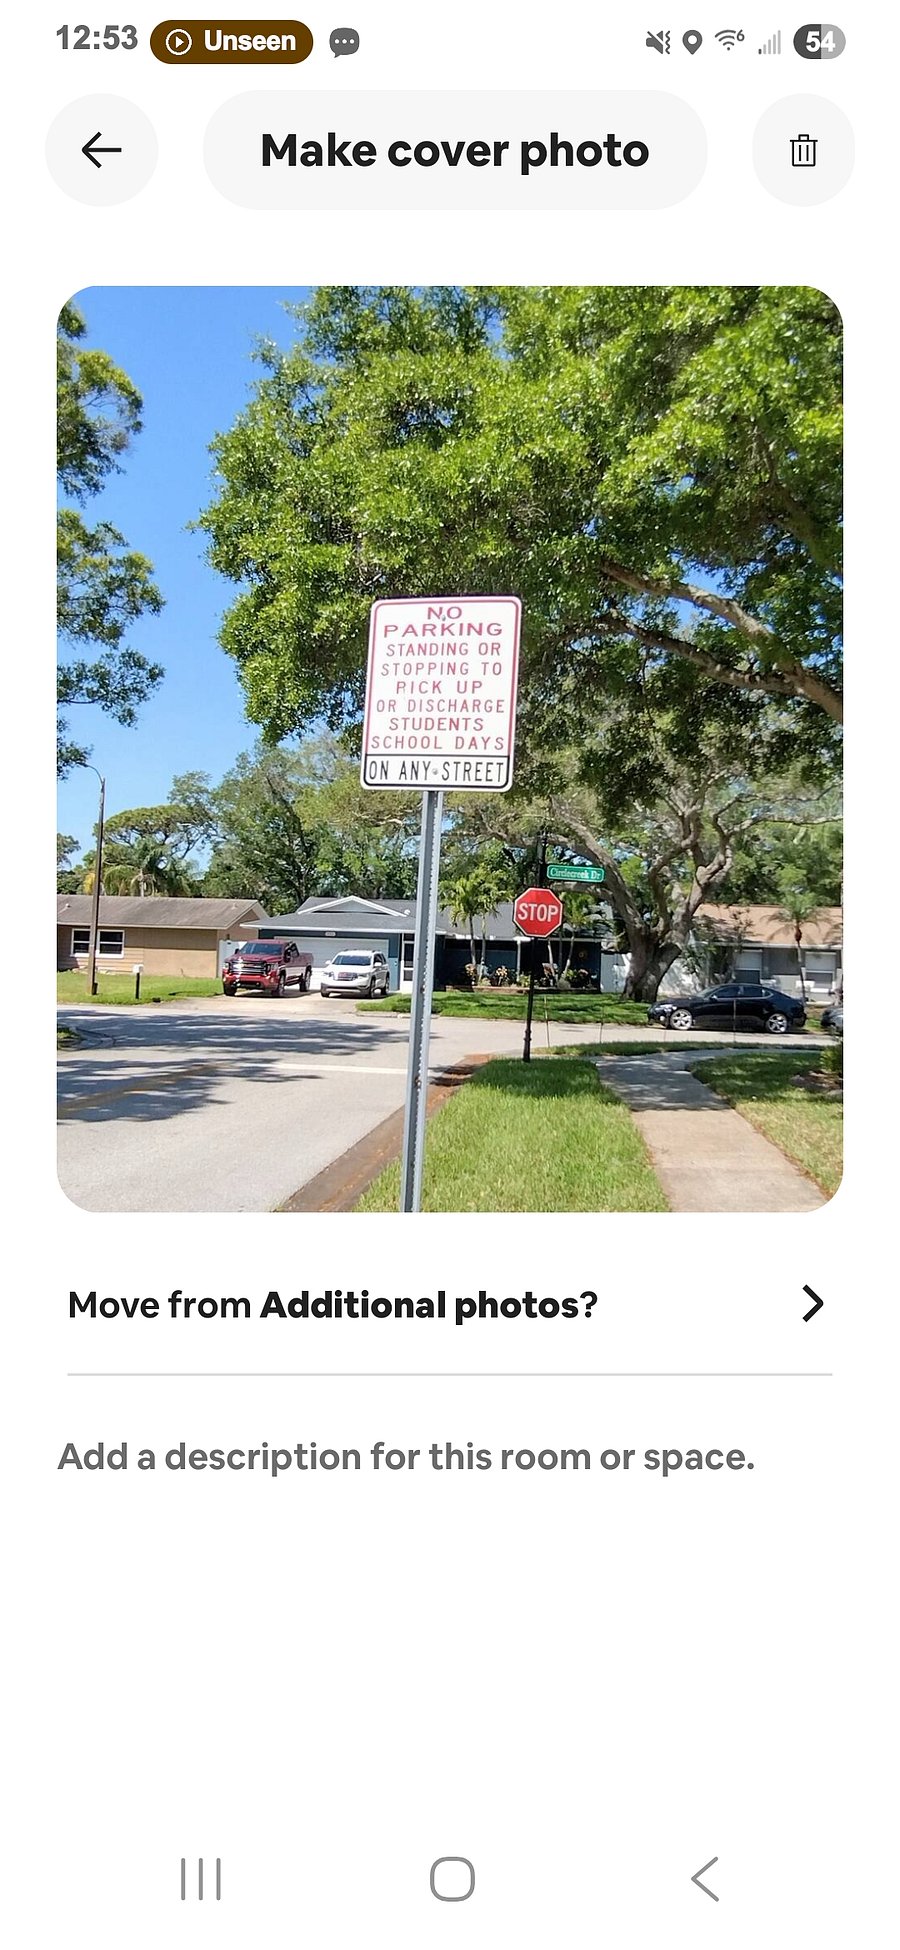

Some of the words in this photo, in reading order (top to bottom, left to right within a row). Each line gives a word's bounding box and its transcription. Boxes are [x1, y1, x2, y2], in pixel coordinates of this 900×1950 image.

[57, 25, 138, 50] 12:53
[205, 30, 295, 51] Unseen
[805, 31, 836, 53] 54
[262, 132, 377, 167] Make
[388, 141, 509, 167] cover
[521, 132, 649, 175] photo
[428, 606, 462, 620] NO
[384, 622, 503, 638] PARKING
[386, 642, 469, 657] STANDING
[478, 642, 501, 656] OR
[381, 662, 469, 676] STOPPING
[482, 662, 502, 676] TO
[397, 681, 442, 694] PICK
[457, 681, 483, 694] UP
[377, 700, 396, 713] OR
[408, 699, 505, 713] DISCHARGE
[389, 718, 484, 731] STUDENTS
[371, 736, 443, 750] SCHOOL
[455, 736, 504, 751] DAYS
[369, 760, 389, 780] ON
[399, 761, 431, 781] ANY
[441, 761, 504, 782] STREET
[591, 870, 601, 880] Dr
[518, 903, 558, 922] STOP
[68, 1291, 159, 1318] Move
[168, 1290, 250, 1318] from
[260, 1290, 445, 1318] Additional
[456, 1290, 597, 1325] photos?
[57, 1442, 127, 1470] Add
[138, 1449, 155, 1470] a
[165, 1442, 361, 1477] description
[371, 1442, 420, 1470] for
[429, 1442, 492, 1470] this
[502, 1449, 590, 1470] room
[600, 1449, 635, 1470] or
[644, 1449, 754, 1477] space.
